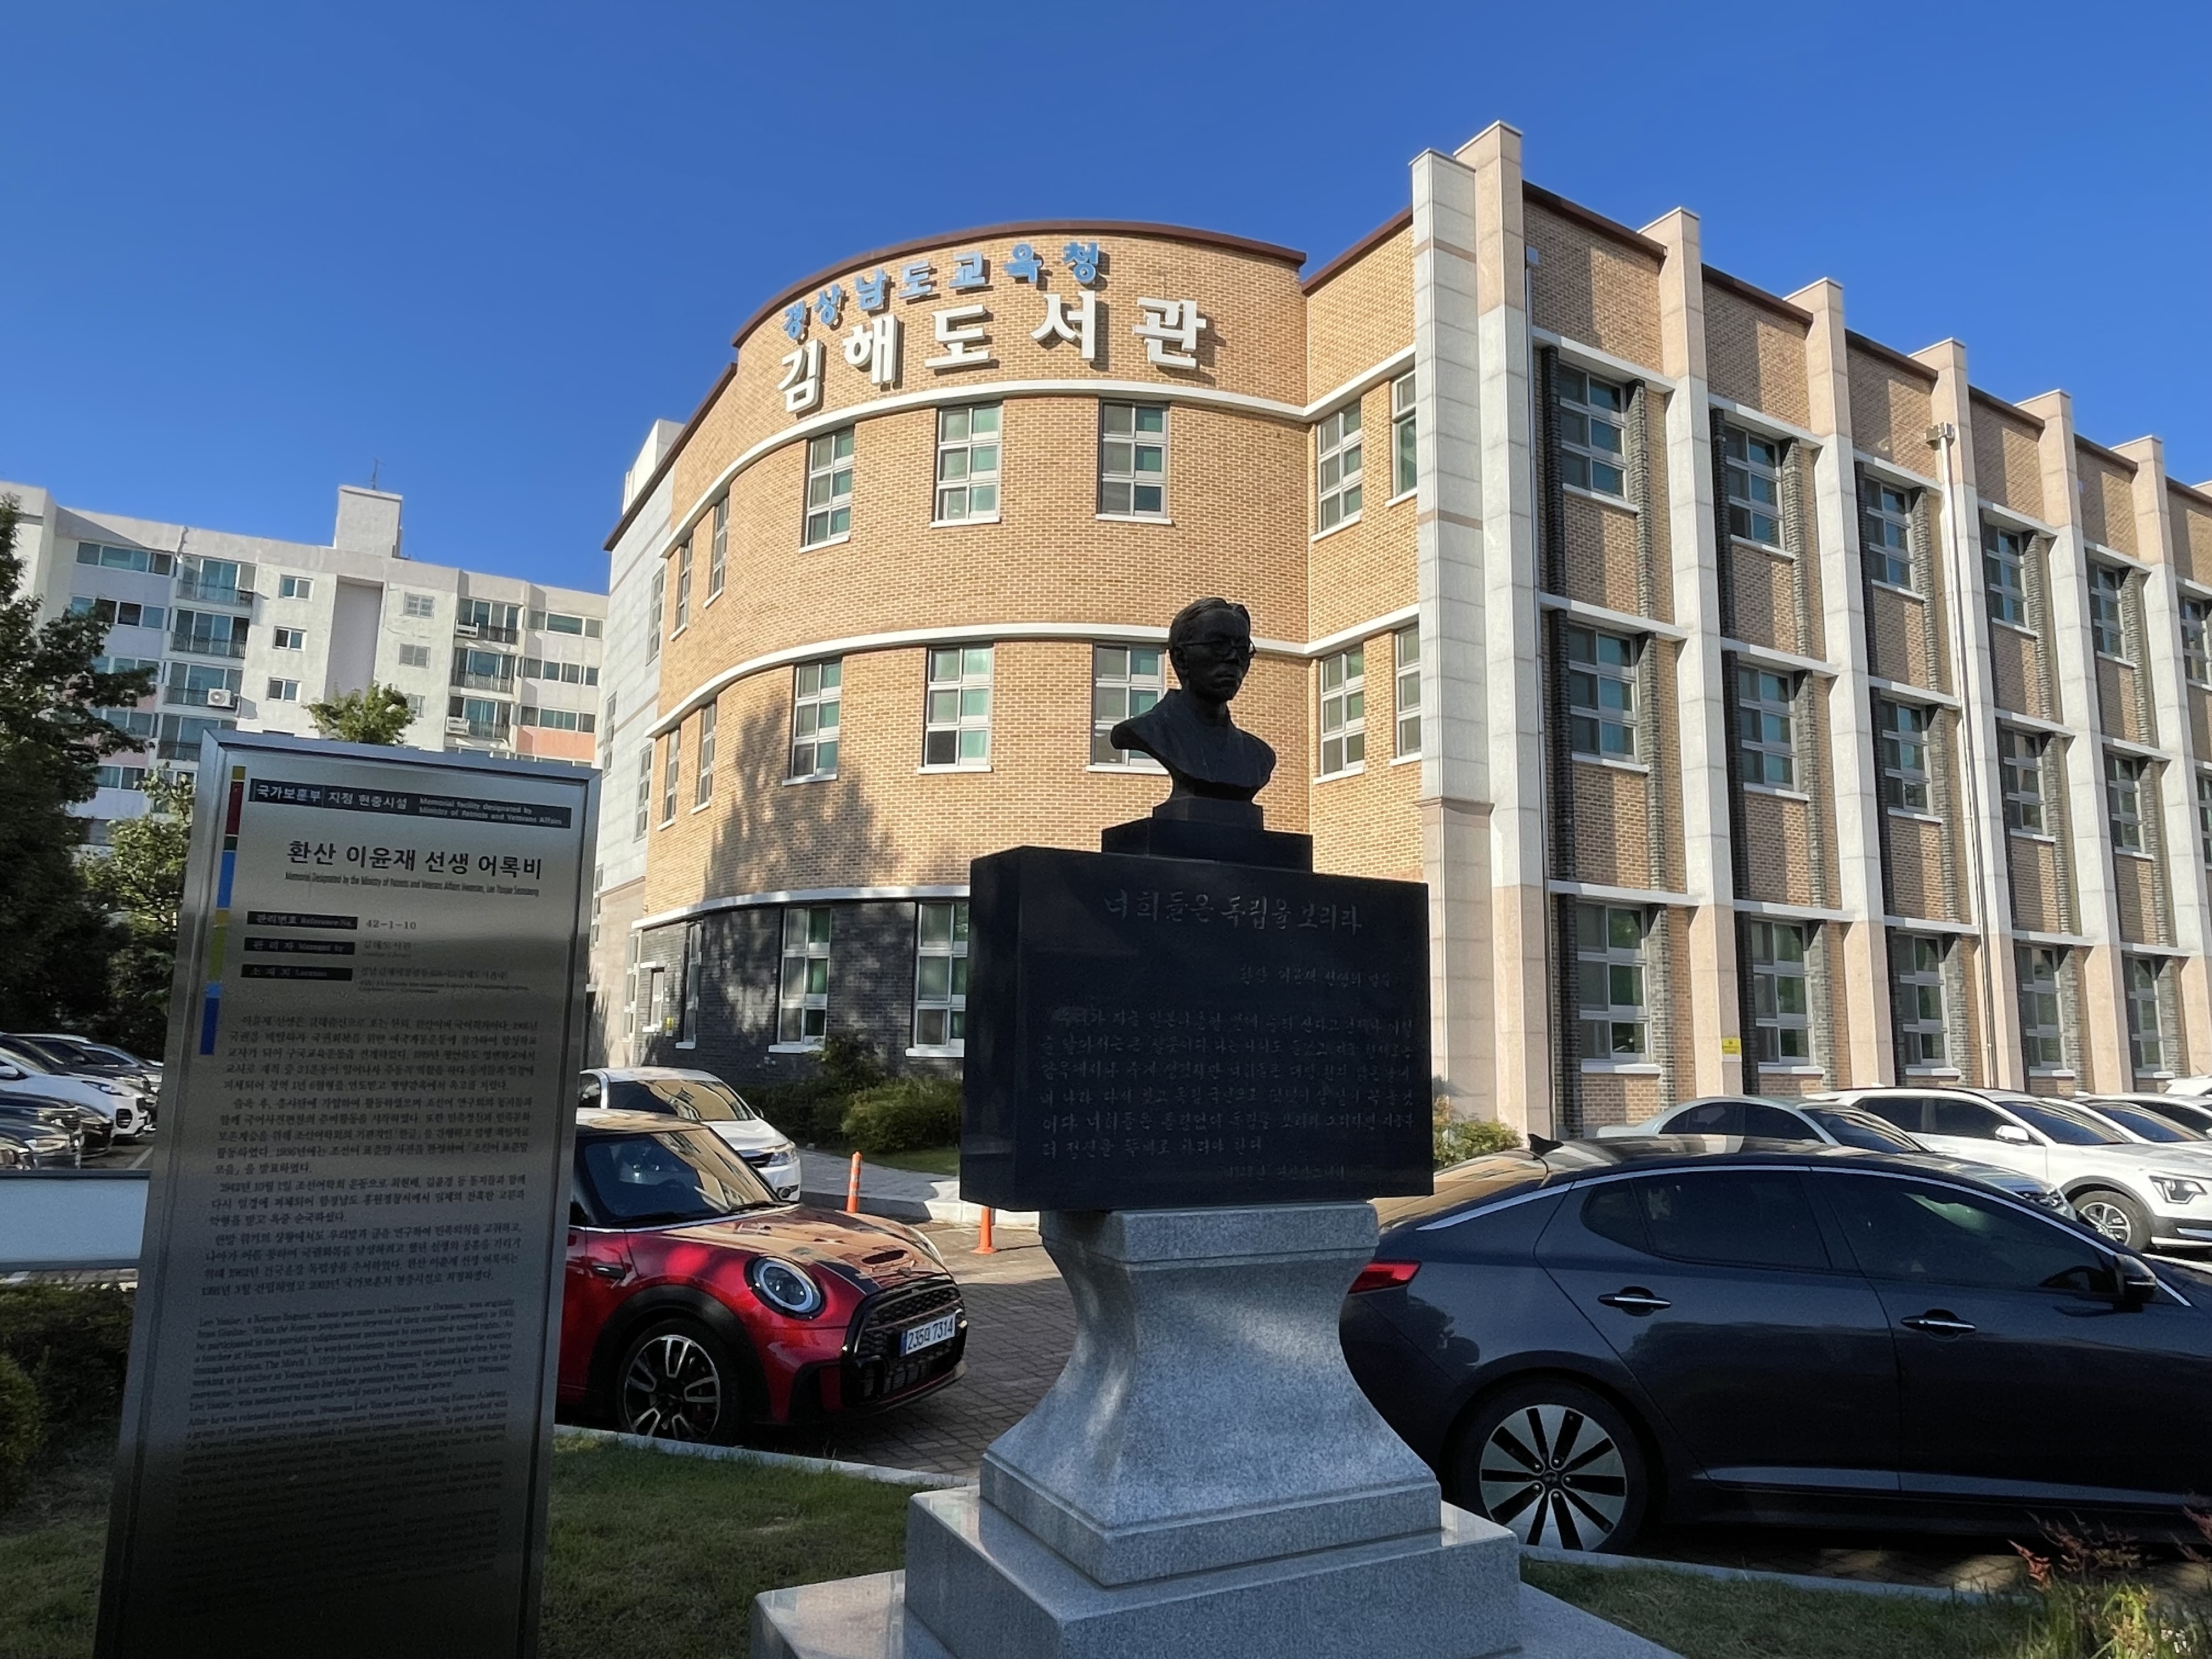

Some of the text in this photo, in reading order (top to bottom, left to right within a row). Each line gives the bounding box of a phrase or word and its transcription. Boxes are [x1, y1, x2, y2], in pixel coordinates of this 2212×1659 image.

[785, 242, 1099, 340] 경상남도교육청
[778, 291, 1207, 413] 김해도서관
[257, 785, 407, 810] 국가보훈부 지정 현충시설
[524, 807, 532, 815] by
[287, 840, 541, 880] 환산 이윤재 선생 어록비
[366, 919, 416, 930] 42-1-10
[1104, 889, 1363, 936] 너희들은 독립을 보리라
[932, 1318, 953, 1340] 7314
